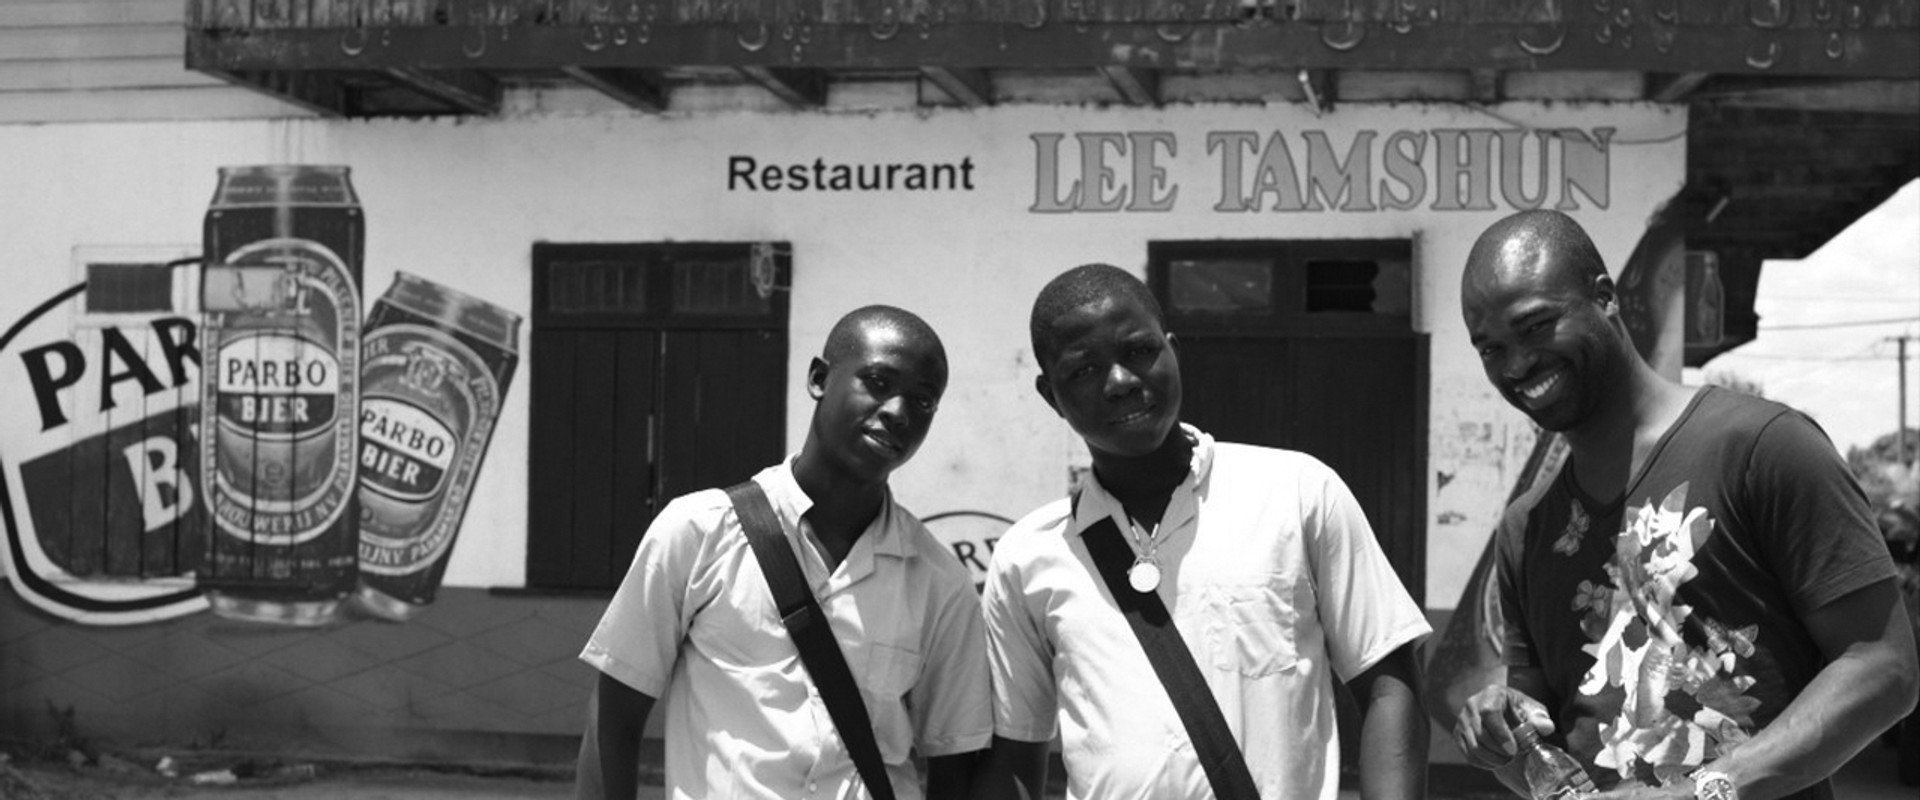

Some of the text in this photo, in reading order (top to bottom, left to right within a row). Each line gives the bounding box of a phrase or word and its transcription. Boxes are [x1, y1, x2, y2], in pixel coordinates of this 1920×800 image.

[727, 156, 975, 191] Restaurant
[1028, 127, 1617, 213] LEE TAMSHUN
[19, 316, 202, 434] PAR
[228, 357, 327, 387] PARBO
[241, 395, 310, 424] BIER
[361, 408, 445, 459] PARBO
[122, 435, 194, 533] B
[360, 443, 421, 487] BIER
